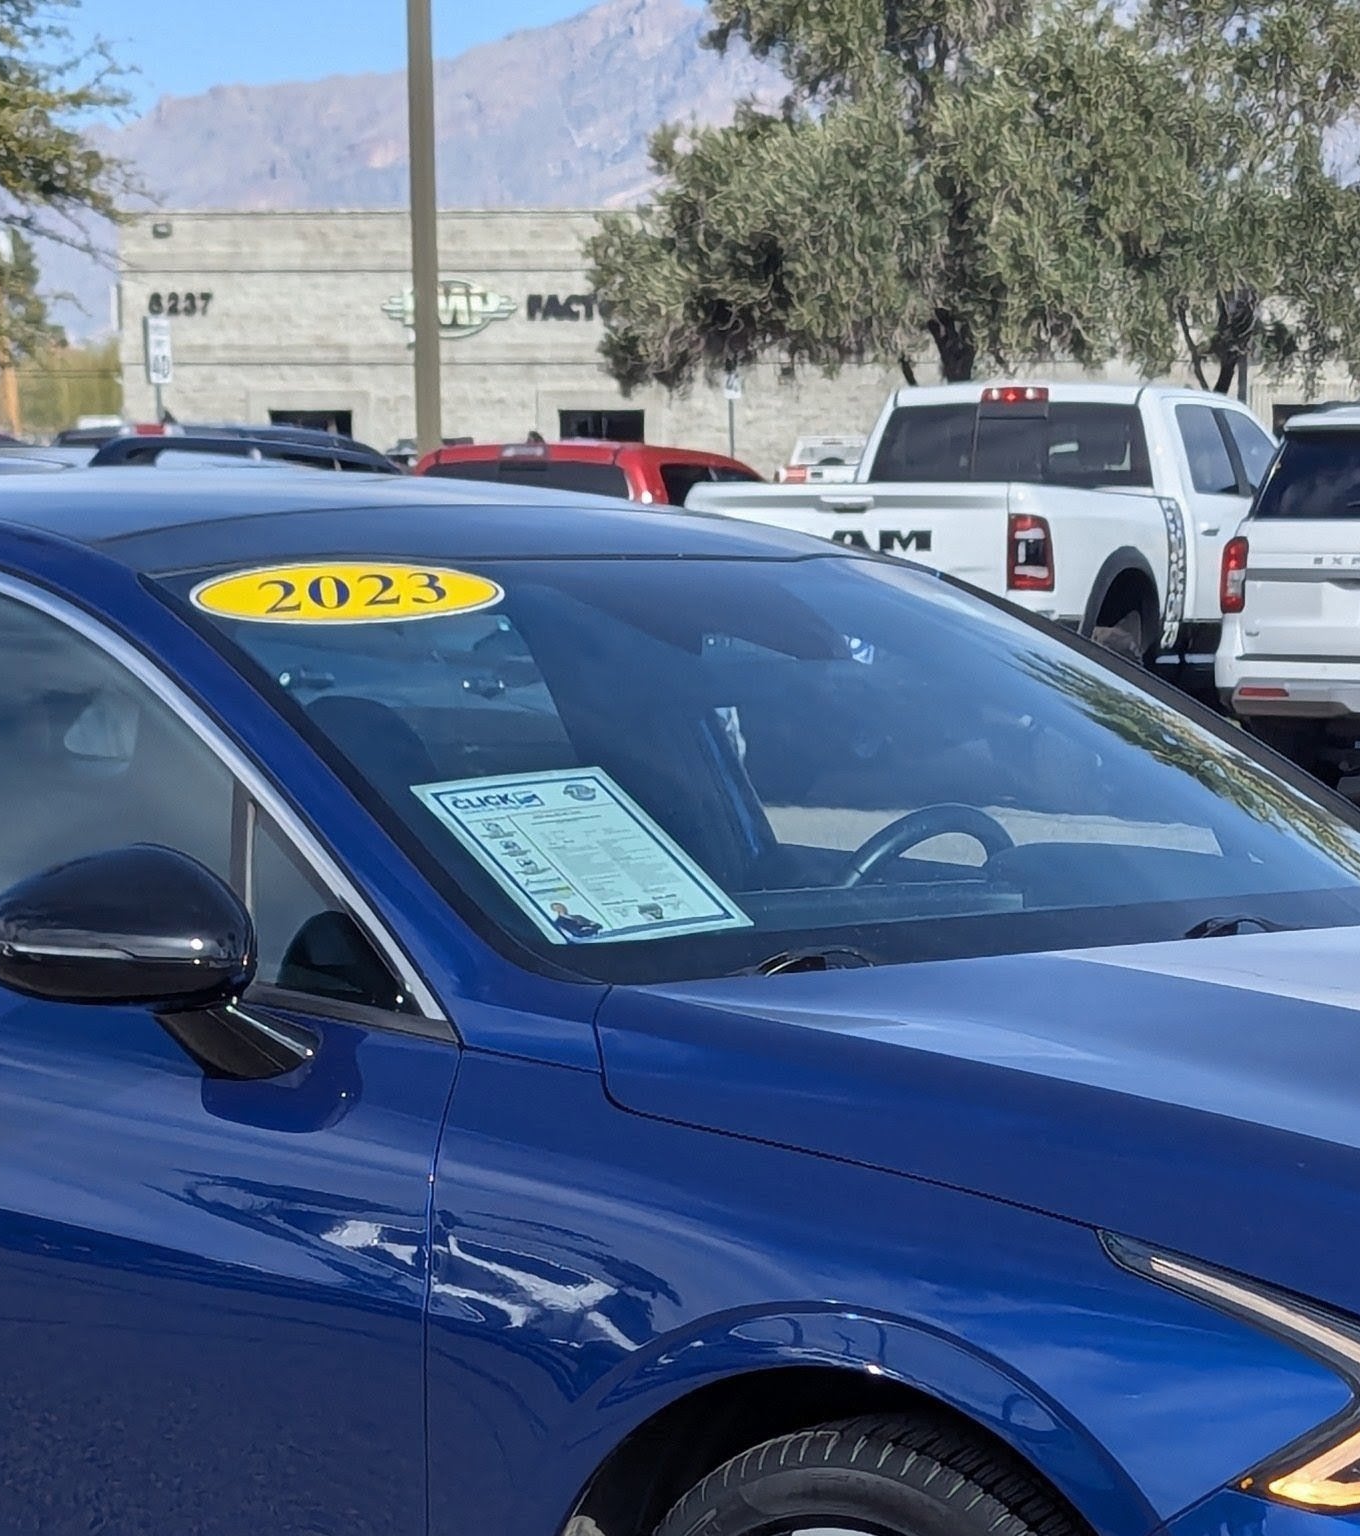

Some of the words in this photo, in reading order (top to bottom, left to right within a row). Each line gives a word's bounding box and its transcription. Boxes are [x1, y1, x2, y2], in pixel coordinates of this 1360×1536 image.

[831, 530, 932, 552] AM
[258, 573, 448, 614] 2023
[451, 793, 517, 810] CLICK
